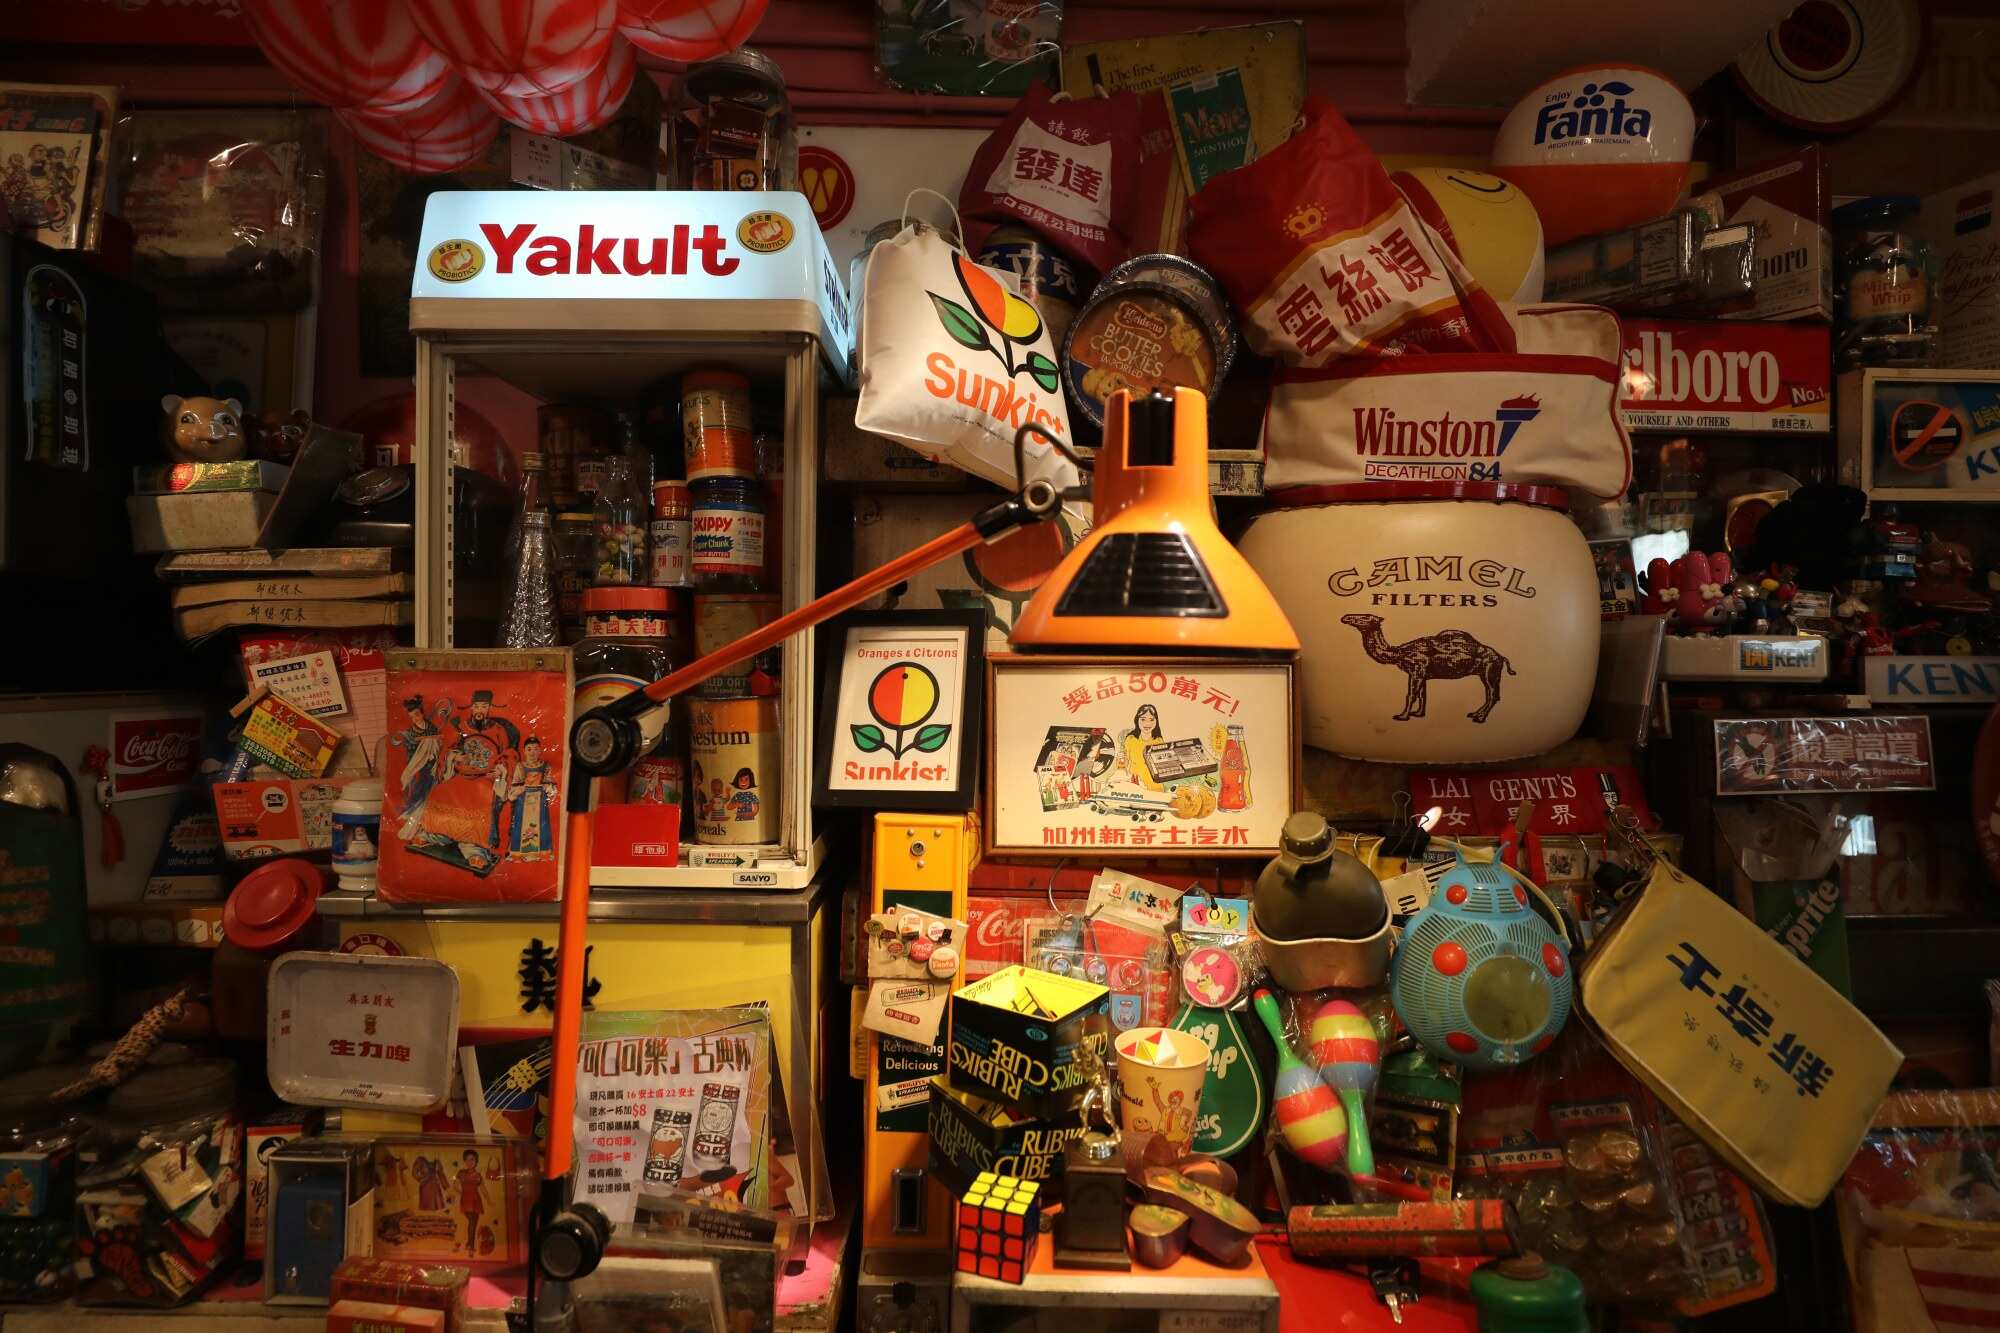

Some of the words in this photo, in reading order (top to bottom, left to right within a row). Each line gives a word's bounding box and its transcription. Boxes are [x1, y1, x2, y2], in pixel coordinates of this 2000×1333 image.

[1545, 90, 1572, 103] Enjoy
[1534, 99, 1652, 146] Fanta
[1014, 146, 1103, 203] 發達
[479, 223, 740, 277] Yakult
[746, 236, 786, 252] PROBIOTICS
[437, 264, 478, 282] PROBIOTICS
[1104, 323, 1162, 359] BUTTER
[1090, 335, 1164, 378] COOKIES
[924, 351, 1068, 458] Sunkist
[1353, 406, 1498, 458] Winston
[1628, 414, 1673, 426] YOURSELF
[1675, 415, 1693, 427] AND
[1696, 416, 1731, 428] OTHERS
[1364, 462, 1467, 480] DECATHLON
[1468, 461, 1503, 483] 84
[1328, 555, 1537, 600] CAMEL
[1372, 593, 1499, 609] FILTERS
[858, 647, 904, 661] Oranges
[912, 646, 959, 659] Citrons
[844, 760, 948, 782] Sunkist
[1489, 773, 1577, 801] GENT'S
[1442, 806, 1472, 827] 女
[1042, 825, 1250, 846] 加州新奇士汽水
[739, 875, 771, 883] SANYO
[1195, 907, 1239, 926] TOY
[328, 1038, 411, 1063] 生力啤
[693, 1034, 752, 1075] 古典杯
[988, 1038, 1050, 1087] CUBE
[885, 1057, 939, 1072] Delicious
[950, 1041, 1024, 1101] RUBIK'S
[994, 1154, 1055, 1180] CUBE
